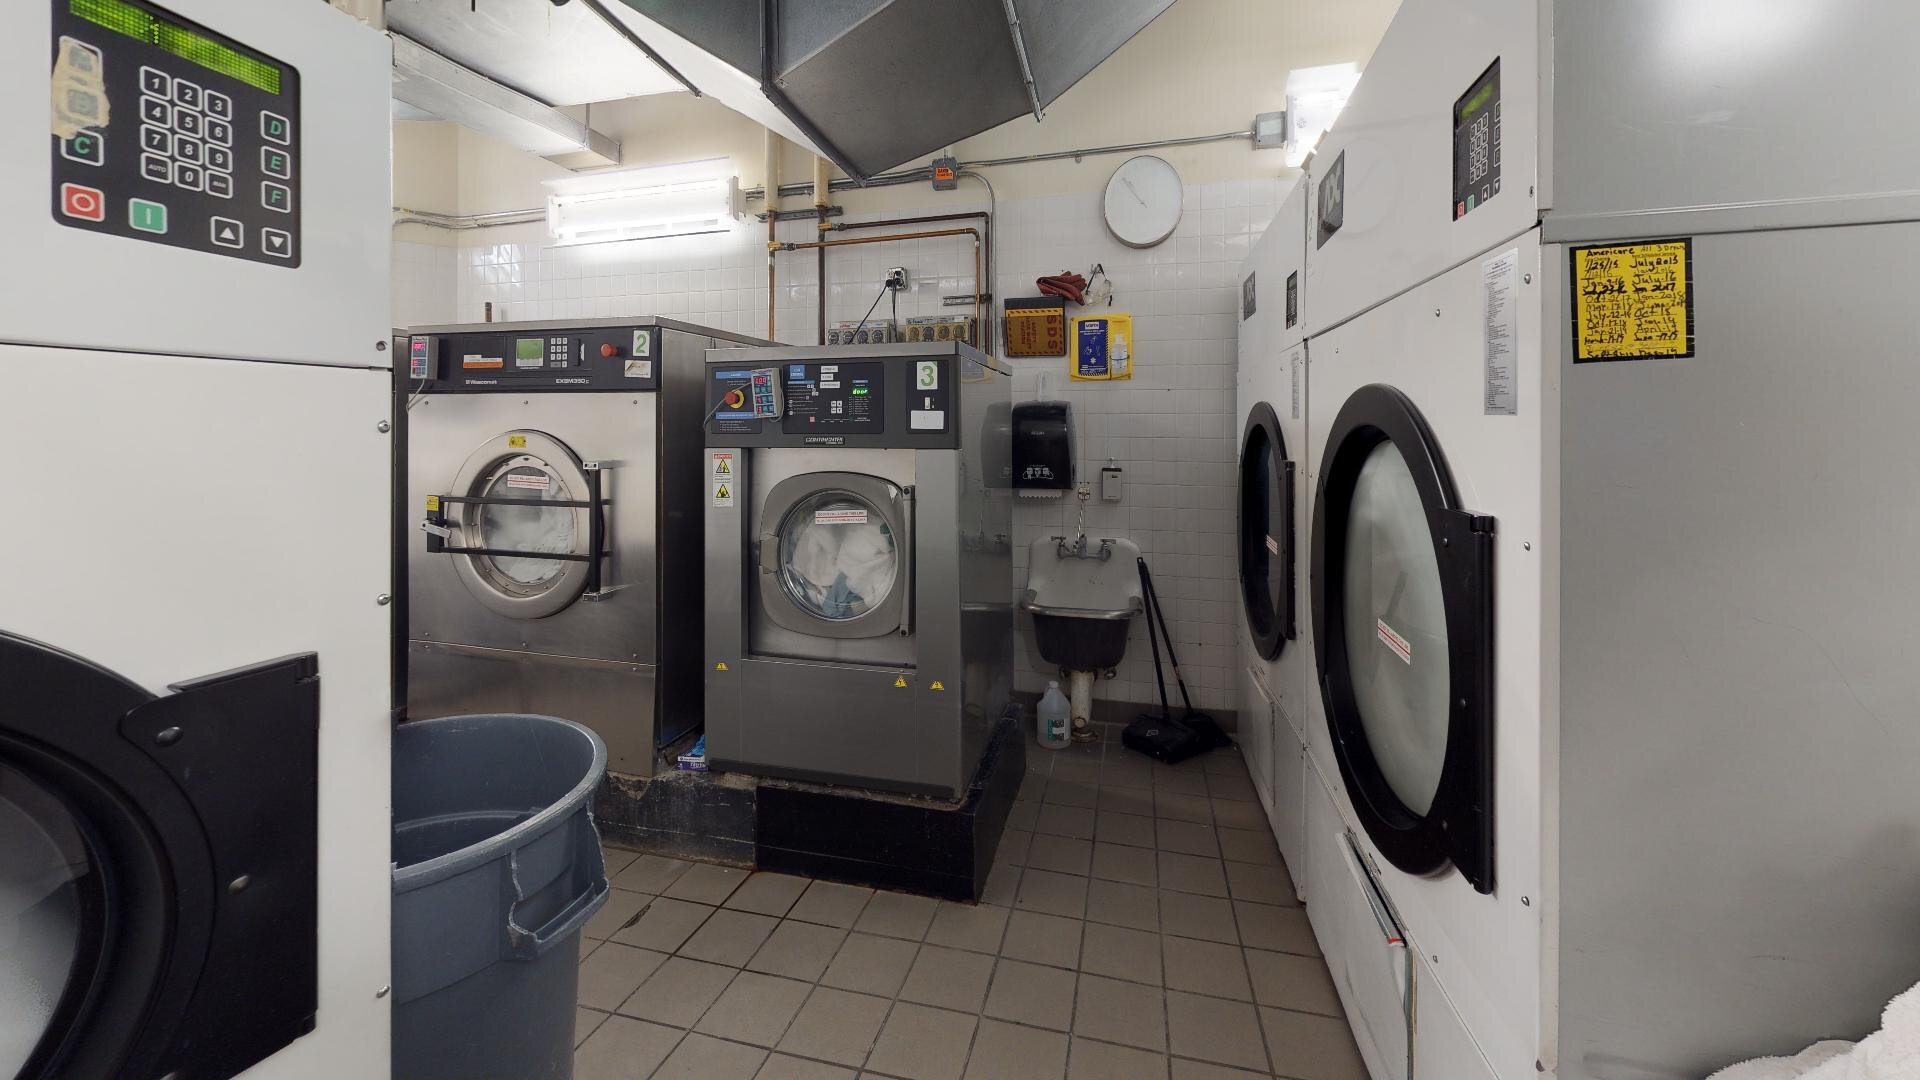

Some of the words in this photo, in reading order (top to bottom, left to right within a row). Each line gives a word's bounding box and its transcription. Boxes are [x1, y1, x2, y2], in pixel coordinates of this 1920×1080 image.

[151, 77, 160, 90] 1
[183, 88, 193, 102] 2
[152, 106, 162, 119] 4
[215, 100, 223, 112] 3
[184, 116, 193, 129] 5
[270, 120, 283, 136] D
[215, 125, 223, 138] 6
[73, 136, 92, 154] C
[152, 133, 161, 146] 7
[184, 143, 193, 156] 8
[215, 152, 223, 165] 9
[270, 156, 282, 170] E
[184, 170, 194, 183] 0
[270, 190, 282, 204] F
[1046, 315, 1058, 349] SDS
[635, 333, 647, 354] 2
[920, 365, 935, 387] 3
